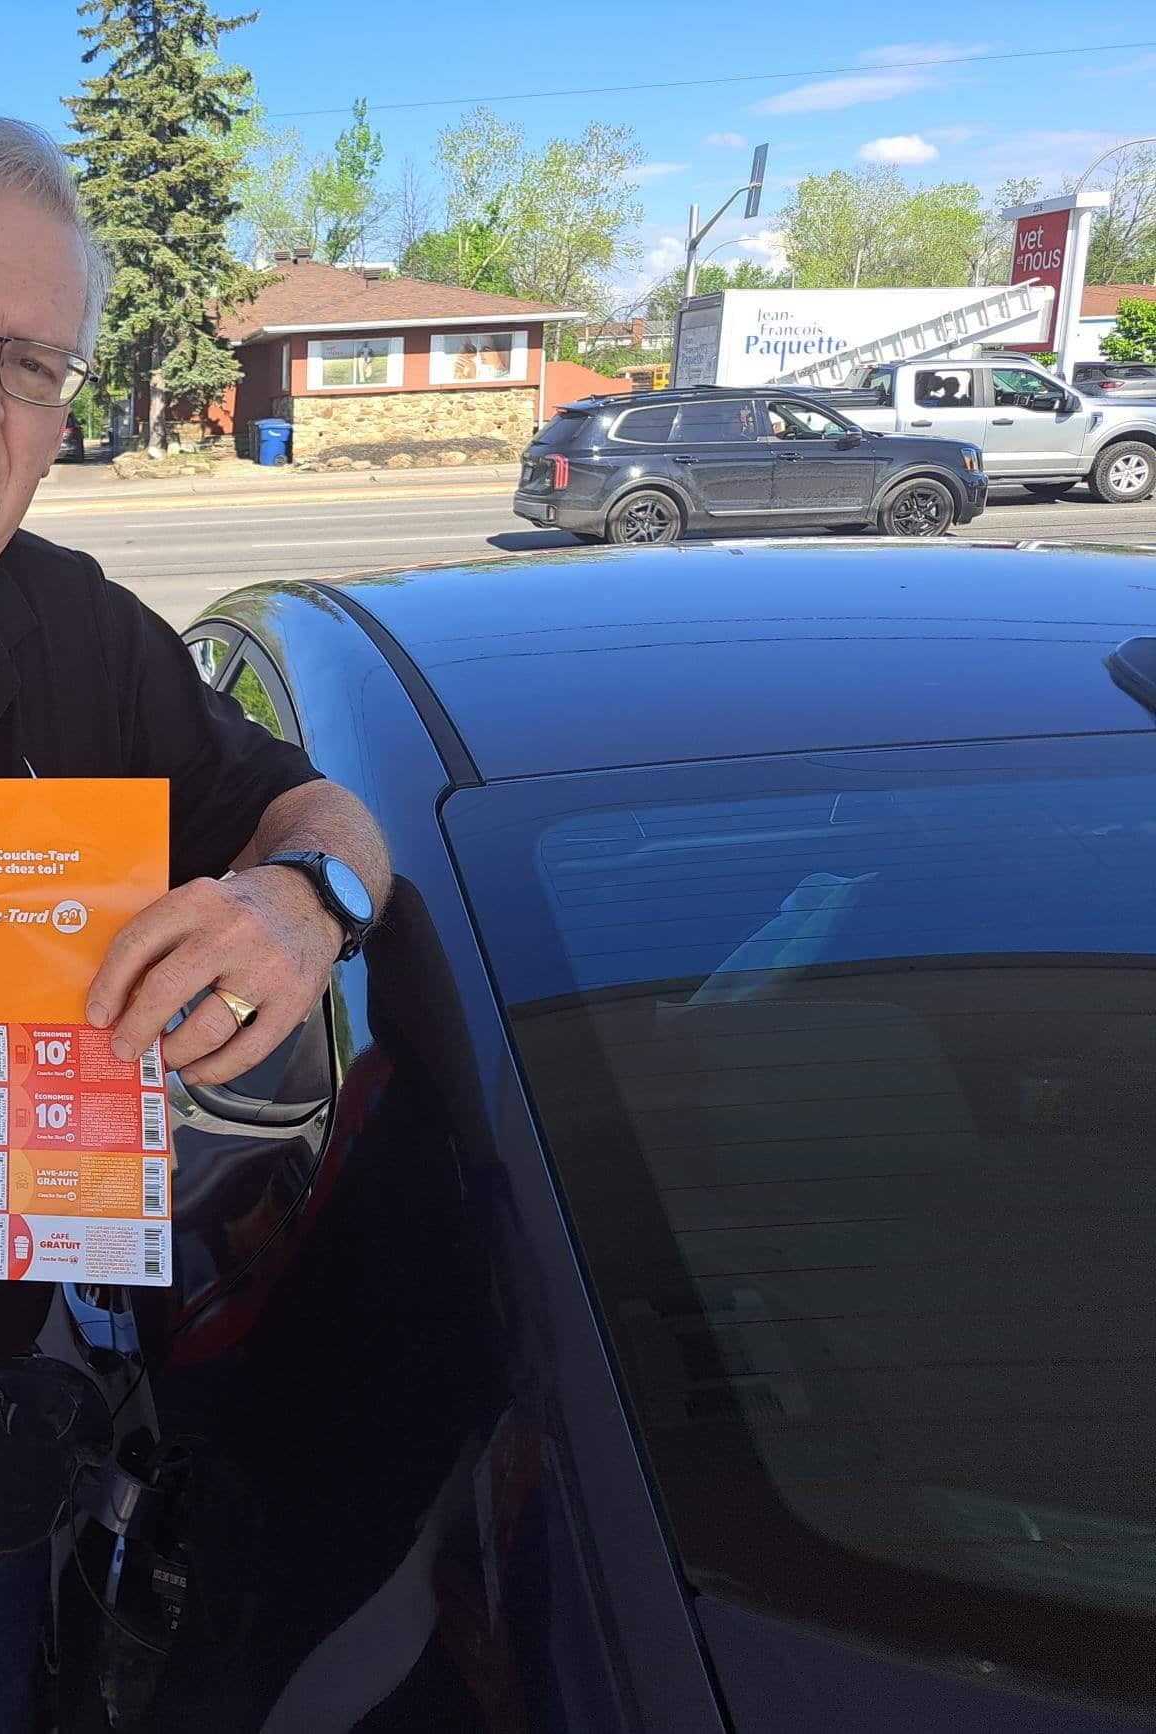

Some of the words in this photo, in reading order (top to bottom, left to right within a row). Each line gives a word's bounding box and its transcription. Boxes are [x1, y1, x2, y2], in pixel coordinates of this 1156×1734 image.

[1019, 225, 1044, 251] vet
[1024, 249, 1061, 272] nous
[757, 307, 795, 322] Jean-
[745, 335, 848, 372] Paquette
[5, 864, 35, 874] chez
[37, 864, 57, 875] toi
[36, 1169, 79, 1177] LAVE-AUTO
[36, 1178, 79, 1187] GRATUIT
[39, 1241, 81, 1250] GRATUIT
